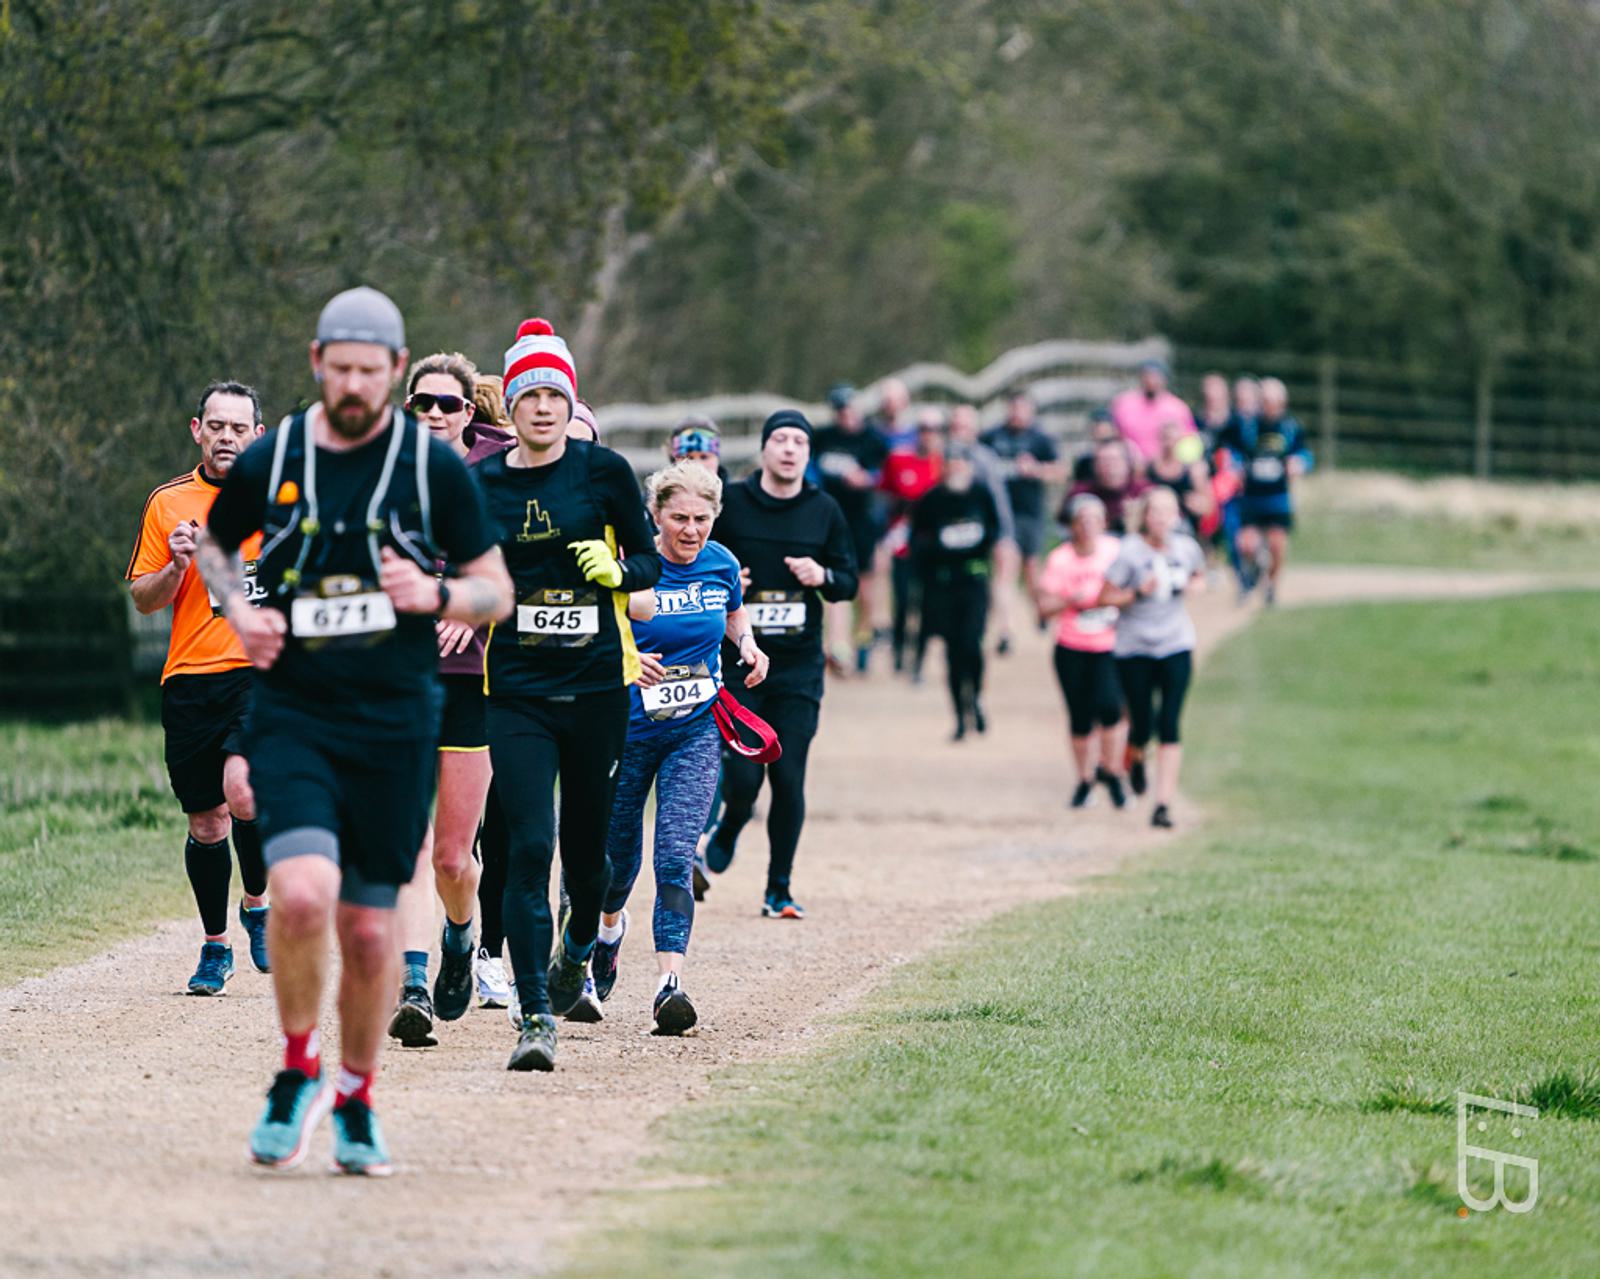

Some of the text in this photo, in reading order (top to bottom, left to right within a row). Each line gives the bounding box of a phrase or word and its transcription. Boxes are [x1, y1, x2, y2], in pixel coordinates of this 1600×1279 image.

[313, 602, 369, 627] 671
[533, 609, 582, 630] 645
[755, 606, 792, 622] 127
[659, 682, 701, 704] 304
